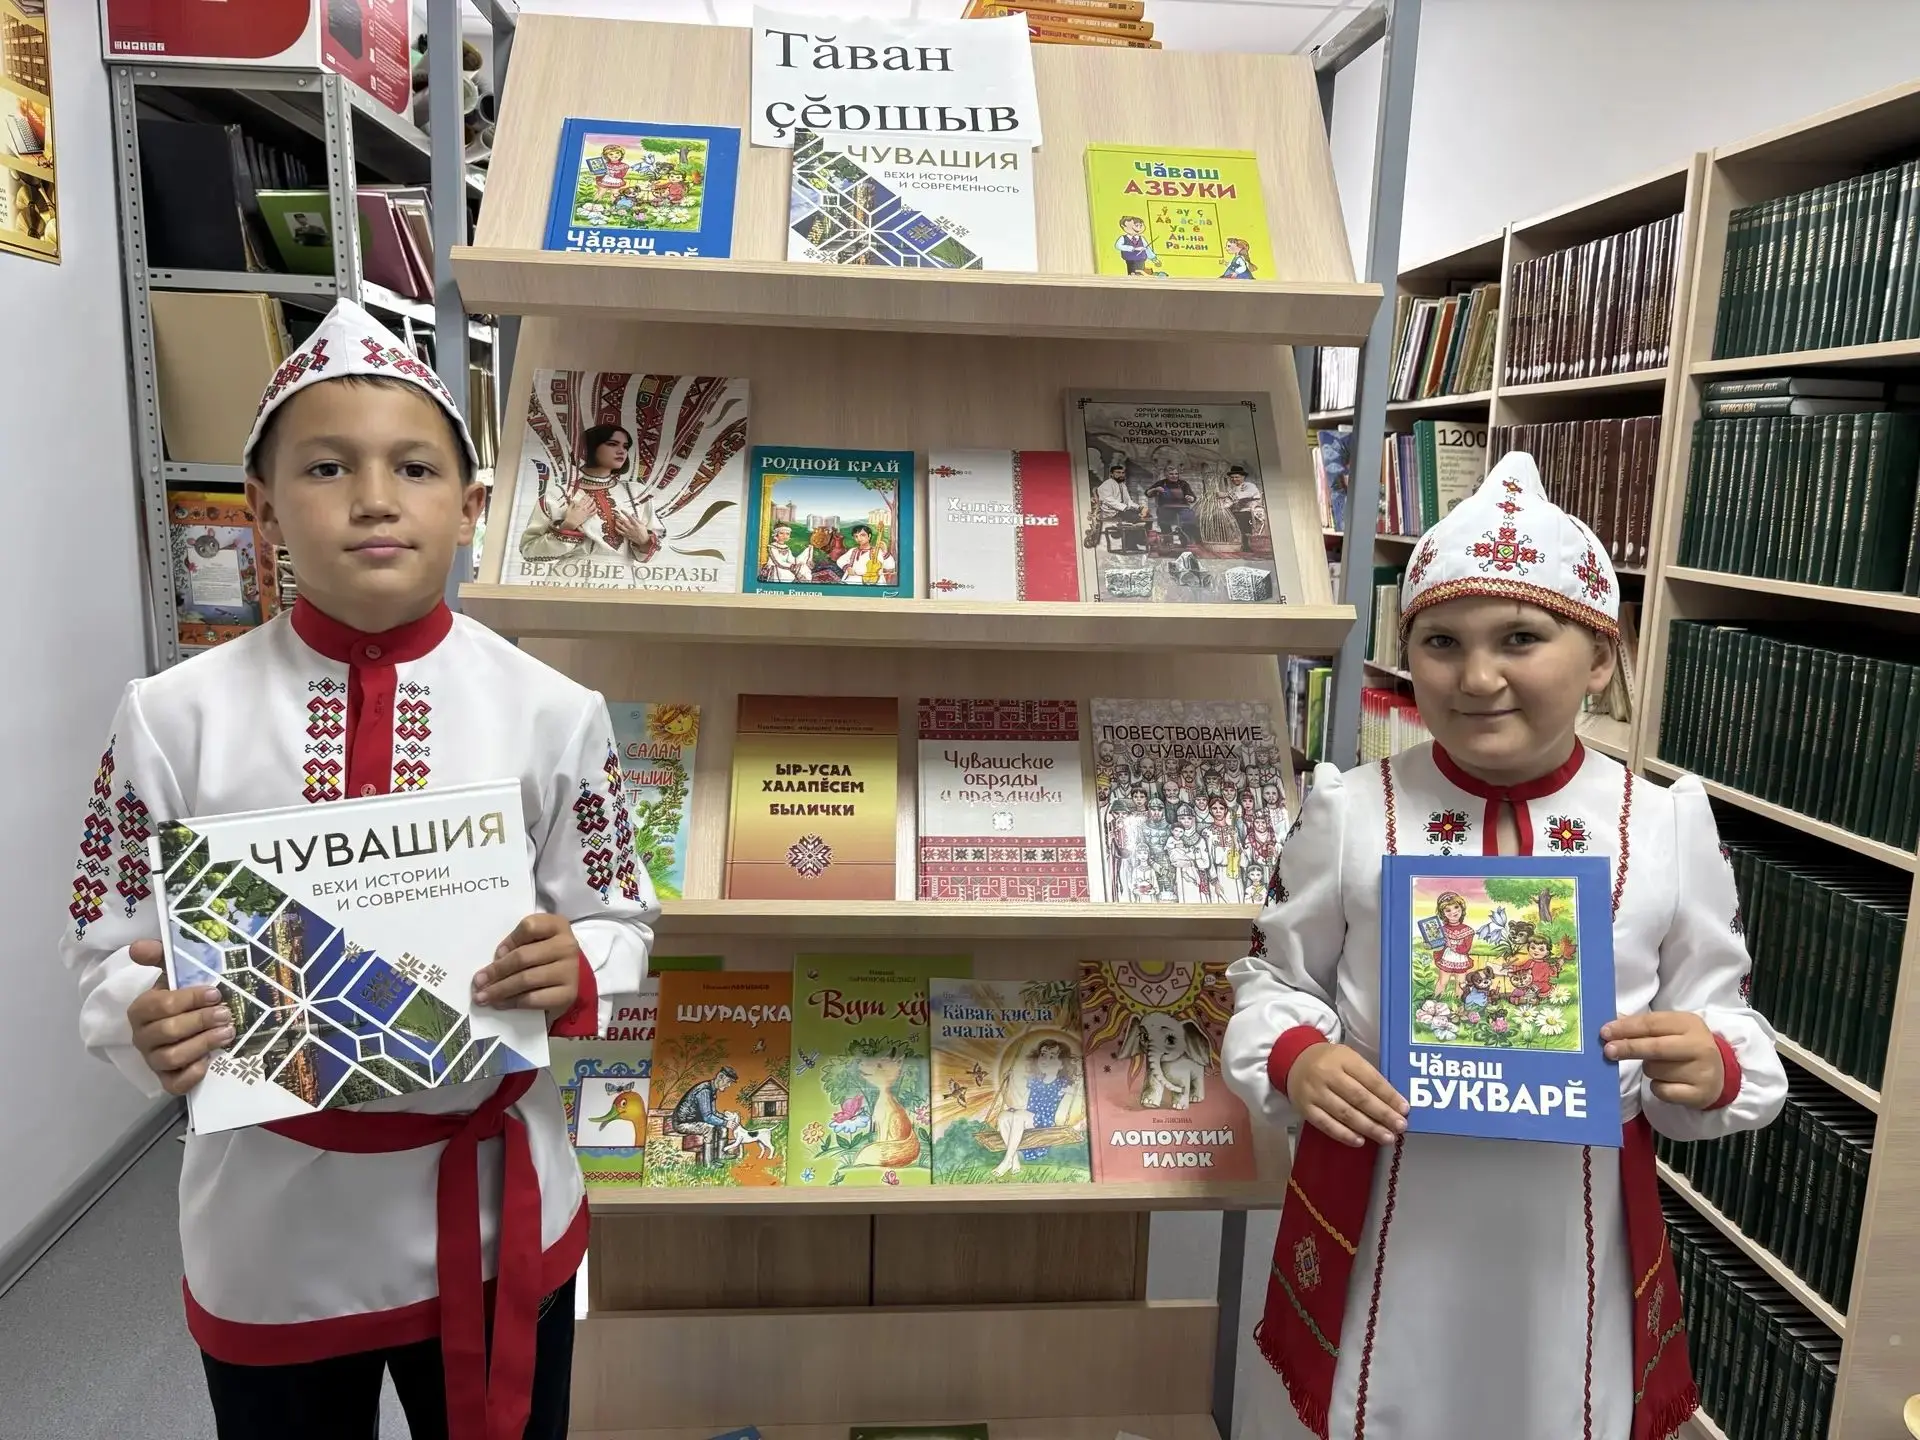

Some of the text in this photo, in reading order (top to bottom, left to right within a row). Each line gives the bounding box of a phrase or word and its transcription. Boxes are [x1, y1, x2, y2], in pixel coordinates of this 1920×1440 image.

[766, 28, 954, 72] Тӑван
[848, 144, 1018, 170] ЧУВАШИЯ
[884, 170, 978, 182] ВЕХИ ИСТОРИИ
[1134, 162, 1220, 180] Чӑваш
[899, 180, 1020, 194] И СОВРЕМЕННОСТЬ
[1124, 180, 1236, 199] АЗБУКИ
[567, 230, 655, 250] Чӑваш
[1114, 420, 1225, 429] ГОРОДА И ПОСЕЛЕНИЯ
[1122, 436, 1220, 445] ПРЕДКОВ ЧУВАШЕЙ
[1438, 428, 1488, 448] 1200
[761, 456, 900, 473] РОДНОЙ КРАЙ
[520, 561, 719, 582] ВЕКОВЫЕ ОБРАЗЫ
[1102, 726, 1263, 741] ПОВЕСТВОВАНИЕ
[626, 742, 682, 760] САЛАМ
[1131, 744, 1238, 759] О ЧУВАШАХ
[776, 764, 852, 776] ЫР-УСАЛ
[944, 750, 1054, 772] Чувашские
[621, 766, 674, 786] УЧШИЙ
[964, 773, 1038, 789] обряды
[762, 778, 864, 793] ХАЛАПӖСЕМ
[959, 786, 1062, 804] праздники
[770, 803, 855, 816] БЫЛИЧКИ
[250, 812, 506, 874] ЧУВАШИЯ
[312, 865, 450, 898] ВЕХИ ИСТОРИИ
[337, 876, 510, 912] И СОВРЕМЕННОСТЬ
[808, 989, 886, 1026] Вут
[1409, 1052, 1503, 1080] Чӑваш
[1410, 1078, 1587, 1118] БУКВАРӖ
[1110, 1125, 1235, 1146] ЛОПОУХИЙ
[1143, 1152, 1216, 1168] ИЛЮК
